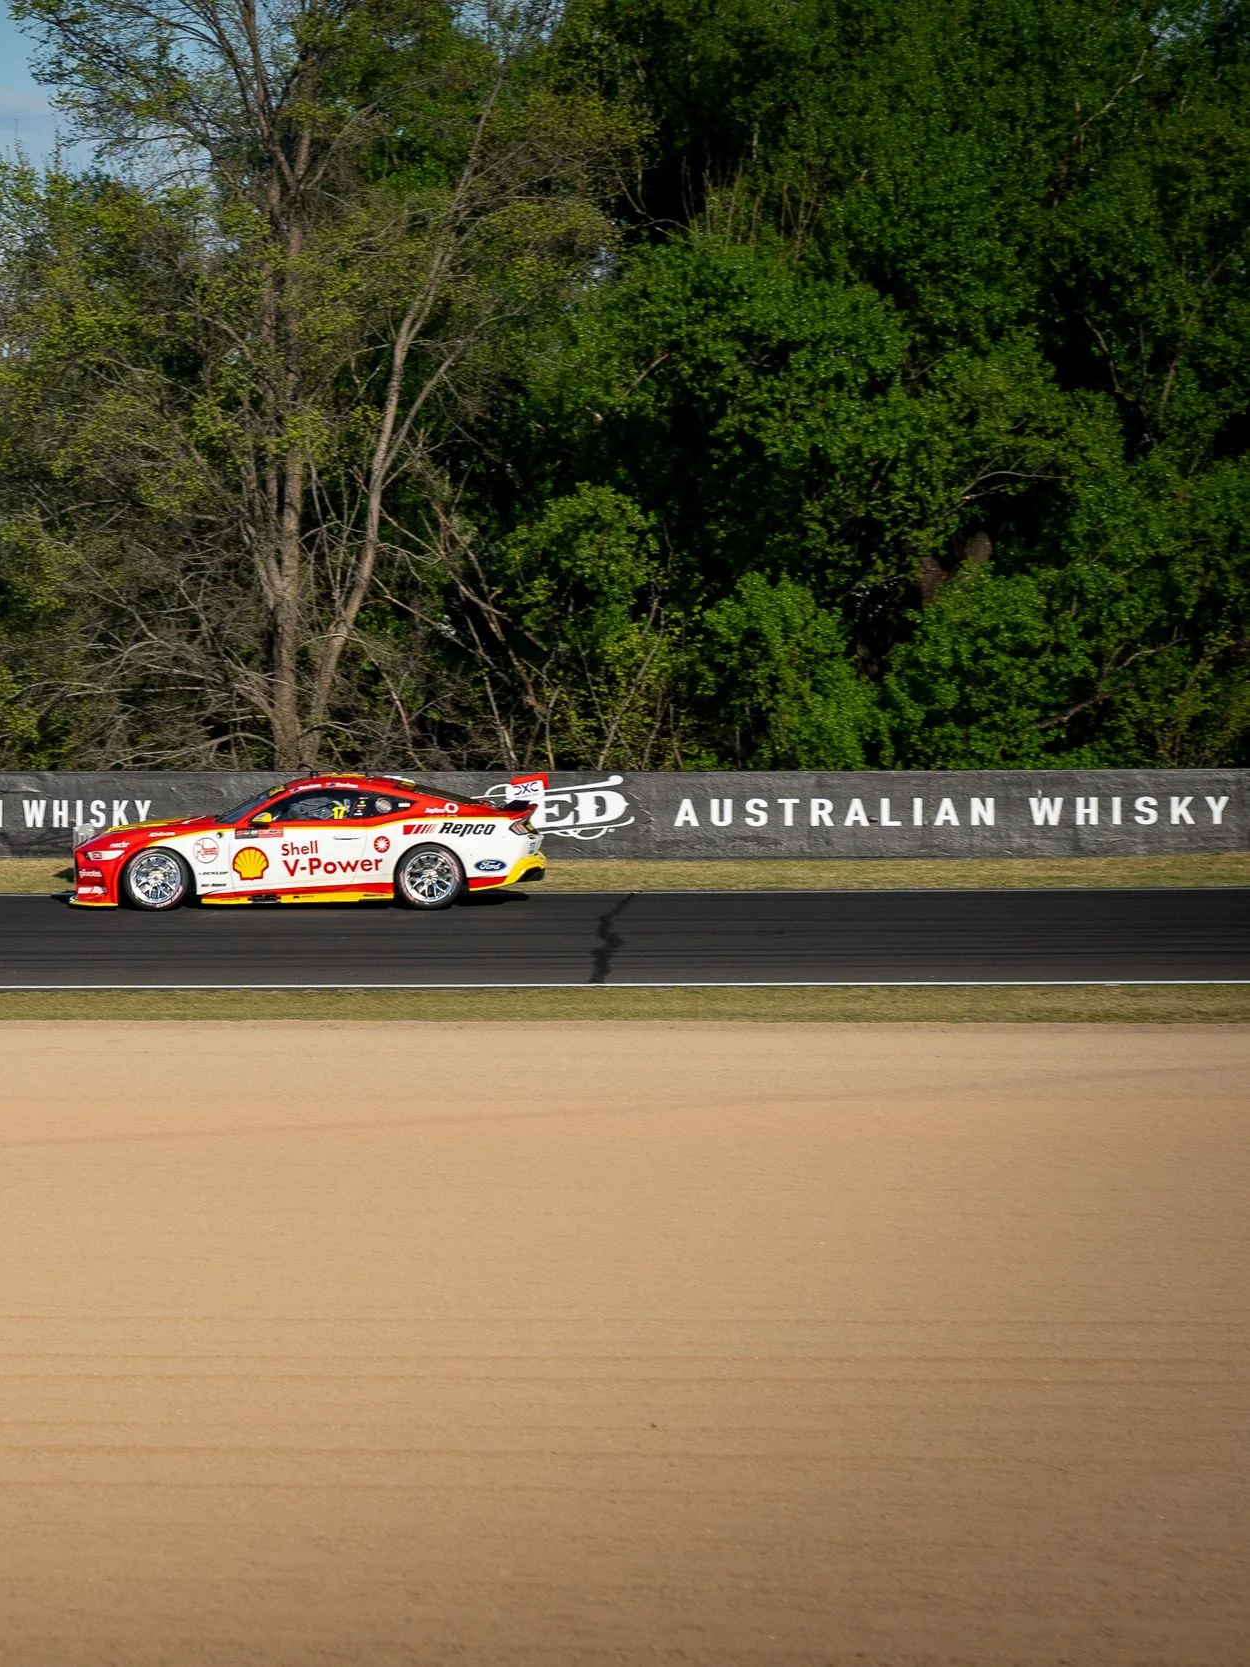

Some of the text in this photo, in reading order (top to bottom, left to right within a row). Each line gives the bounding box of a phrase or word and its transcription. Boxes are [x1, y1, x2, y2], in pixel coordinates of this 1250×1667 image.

[22, 799, 152, 828] WHISKY
[332, 806, 346, 819] 17
[529, 789, 631, 830] ED
[673, 795, 1230, 828] AUSTRALIAN WHISKY
[438, 821, 496, 838] Repco
[281, 840, 319, 857] Shell
[283, 857, 382, 877] V-Power
[478, 860, 502, 871] Ford
